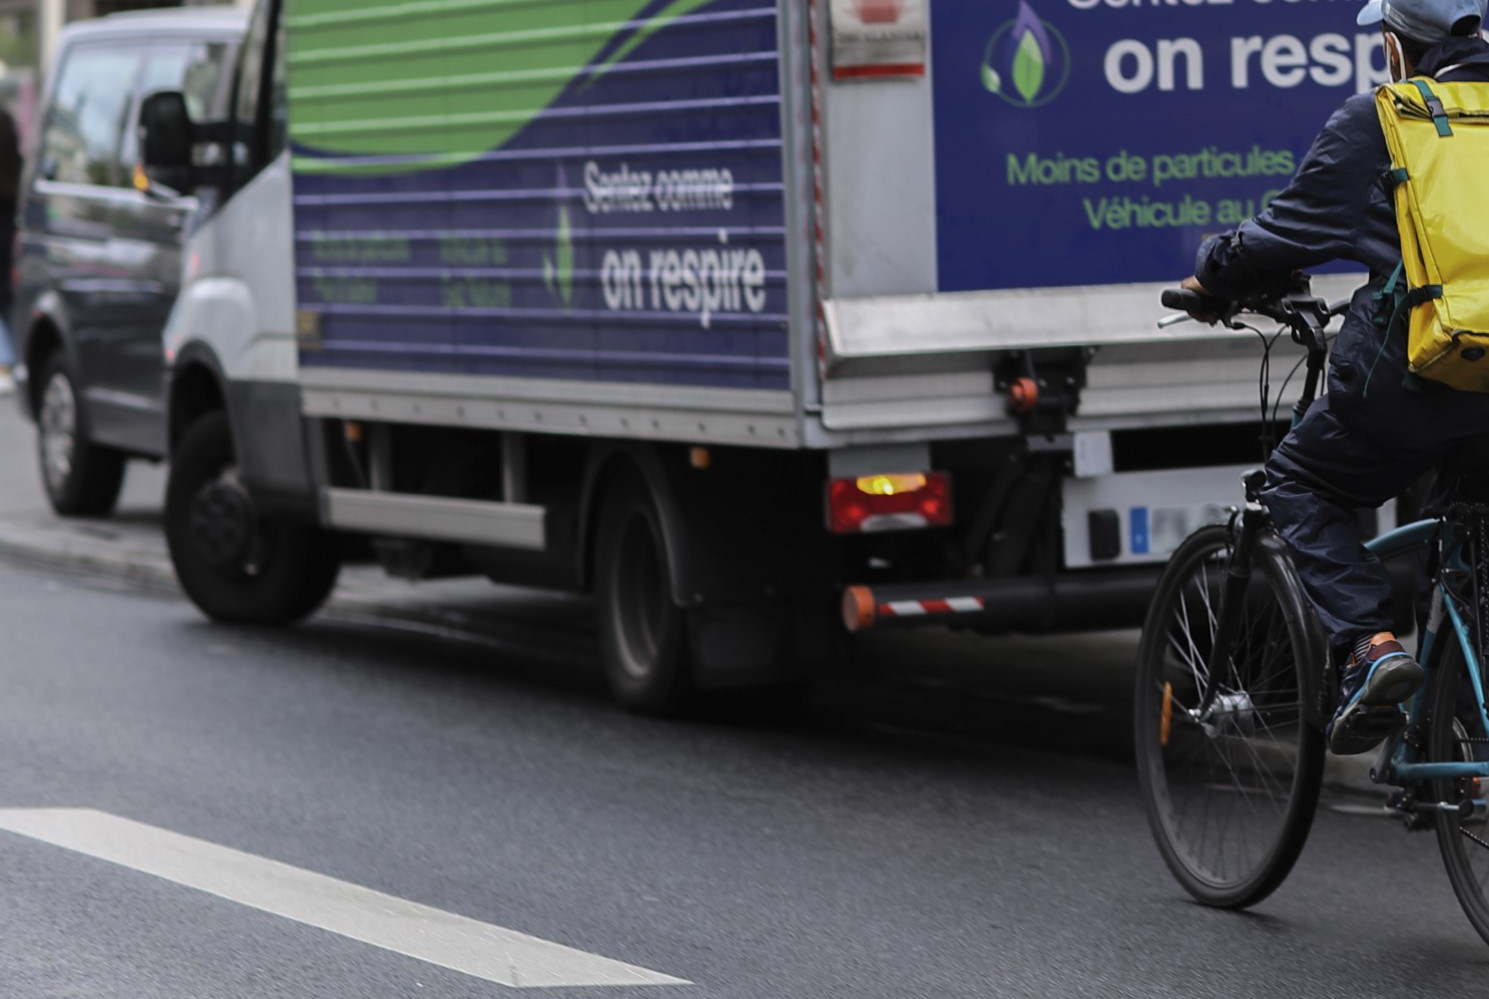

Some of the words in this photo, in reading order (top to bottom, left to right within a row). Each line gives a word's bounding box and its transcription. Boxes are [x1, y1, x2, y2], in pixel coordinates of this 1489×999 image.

[1104, 37, 1204, 94] on
[583, 160, 654, 213] Sentez
[655, 166, 733, 211] comme
[1006, 152, 1100, 185] Moins
[1105, 150, 1146, 182] de
[1153, 144, 1295, 187] particules
[1083, 195, 1210, 230] Véhicule
[1216, 199, 1255, 225] au
[602, 248, 643, 311] on
[649, 228, 766, 328] respire
